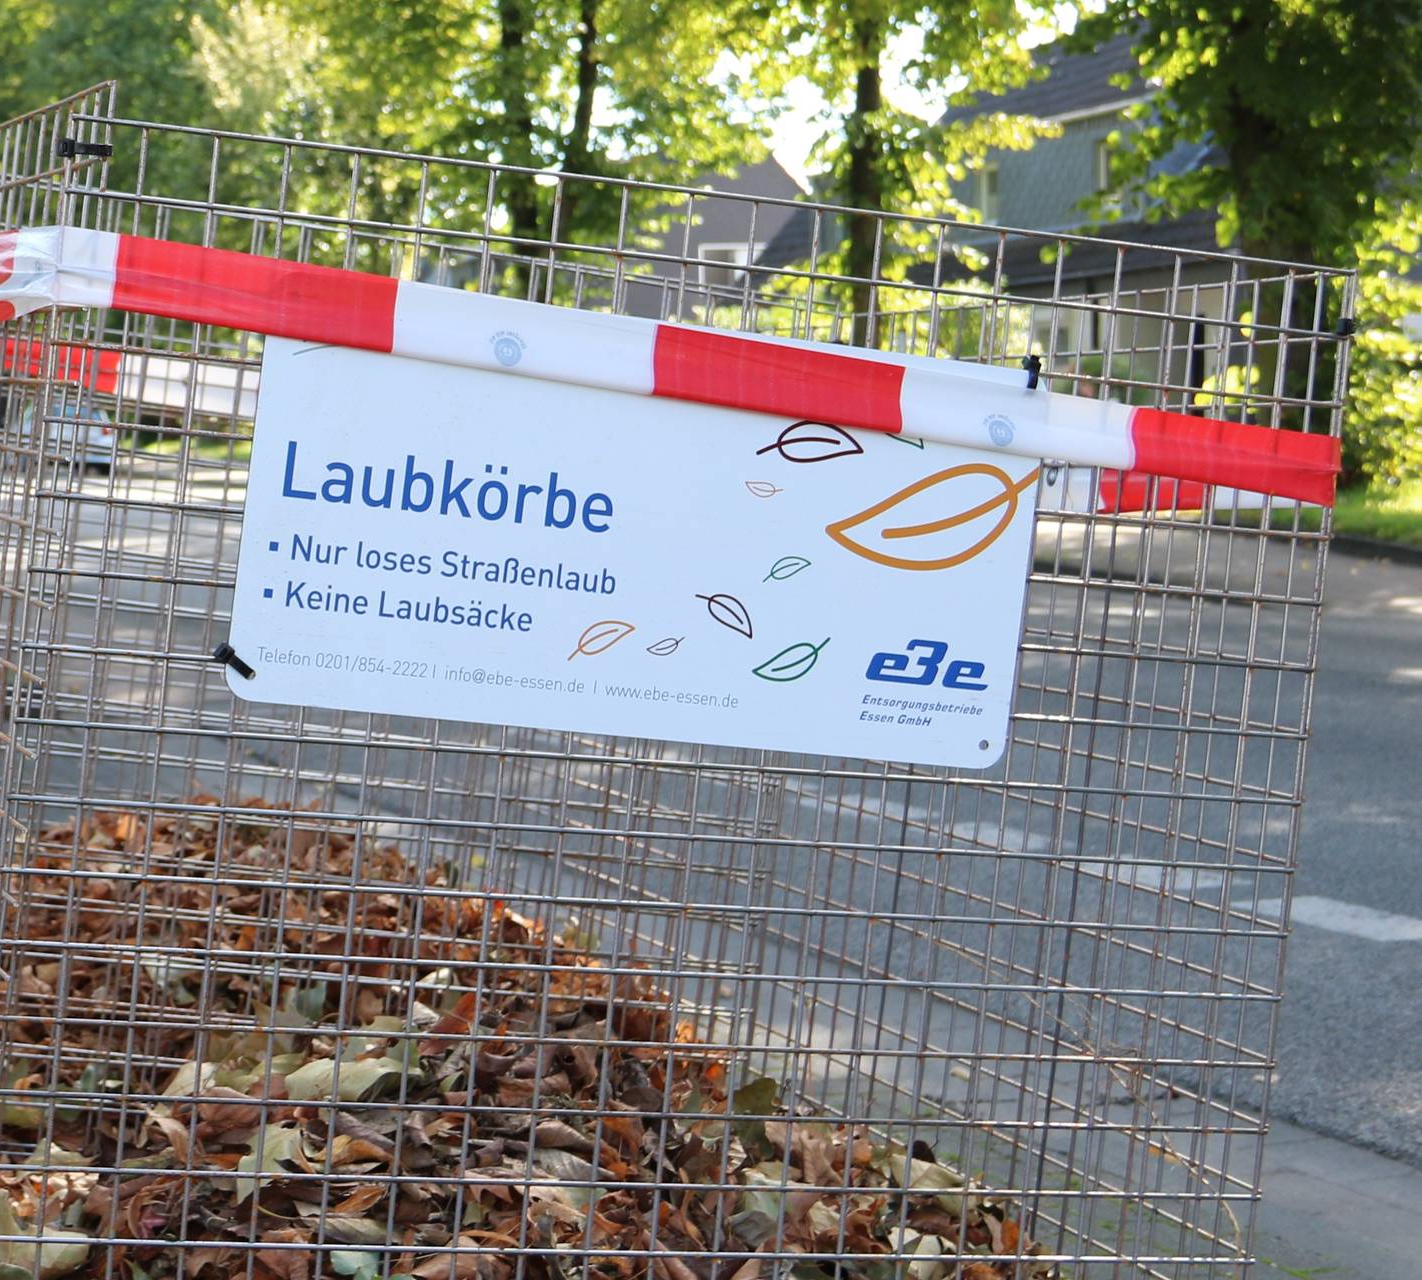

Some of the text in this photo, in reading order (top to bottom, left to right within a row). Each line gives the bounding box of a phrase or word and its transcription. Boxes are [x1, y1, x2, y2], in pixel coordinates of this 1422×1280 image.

[281, 439, 614, 534] Laubkörbe
[290, 533, 617, 596] Nur loses Straßenlaub
[284, 579, 533, 633] Keine Laubsäcke
[257, 646, 739, 709] Telefon 0201/854-2222 info@ebe-essen.de www.ebe-essen.de
[861, 694, 984, 716] Entsorgungsbetriebe
[858, 710, 933, 727] Essen GmbH
